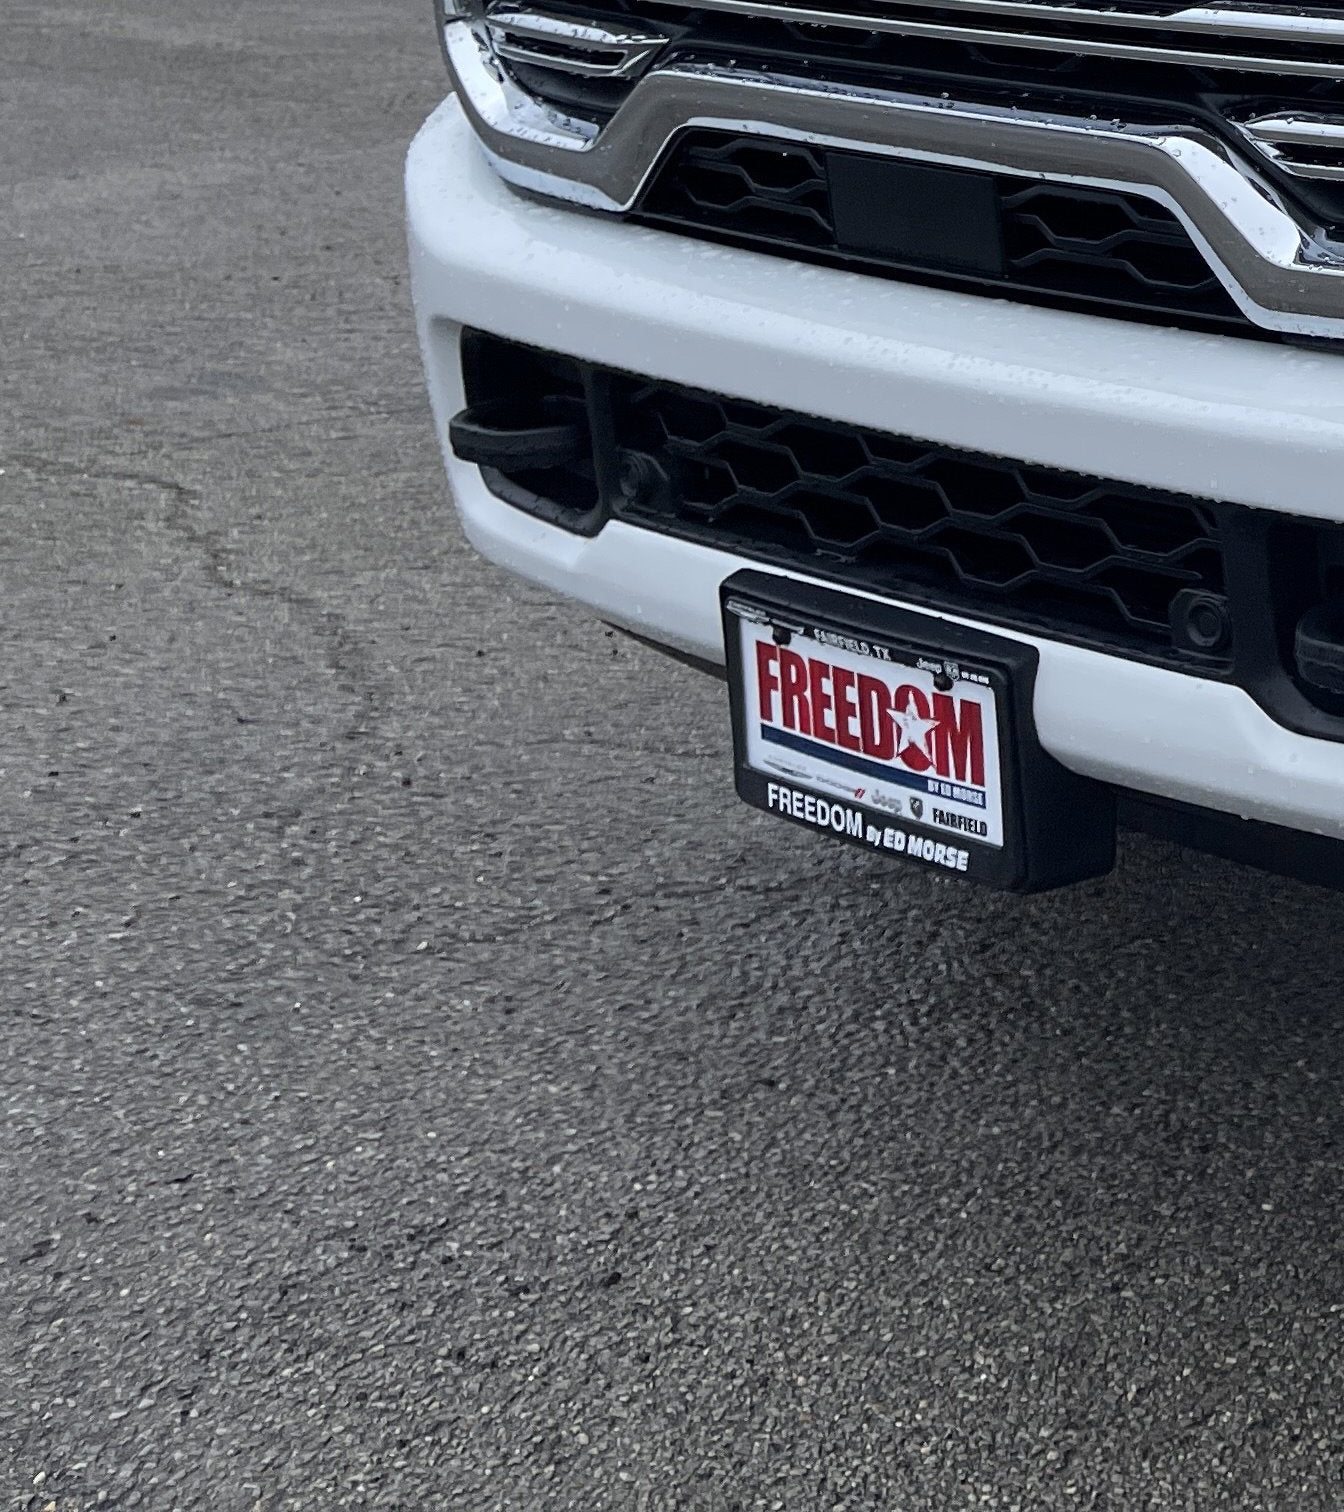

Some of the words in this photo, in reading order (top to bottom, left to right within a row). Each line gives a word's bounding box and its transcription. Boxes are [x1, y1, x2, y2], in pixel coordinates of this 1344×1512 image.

[755, 639, 986, 787] FREEDOM
[766, 781, 863, 840] FREEDOM
[882, 826, 906, 852] ED
[906, 833, 970, 872] MORSE
[932, 807, 988, 838] FAIRFIELD
